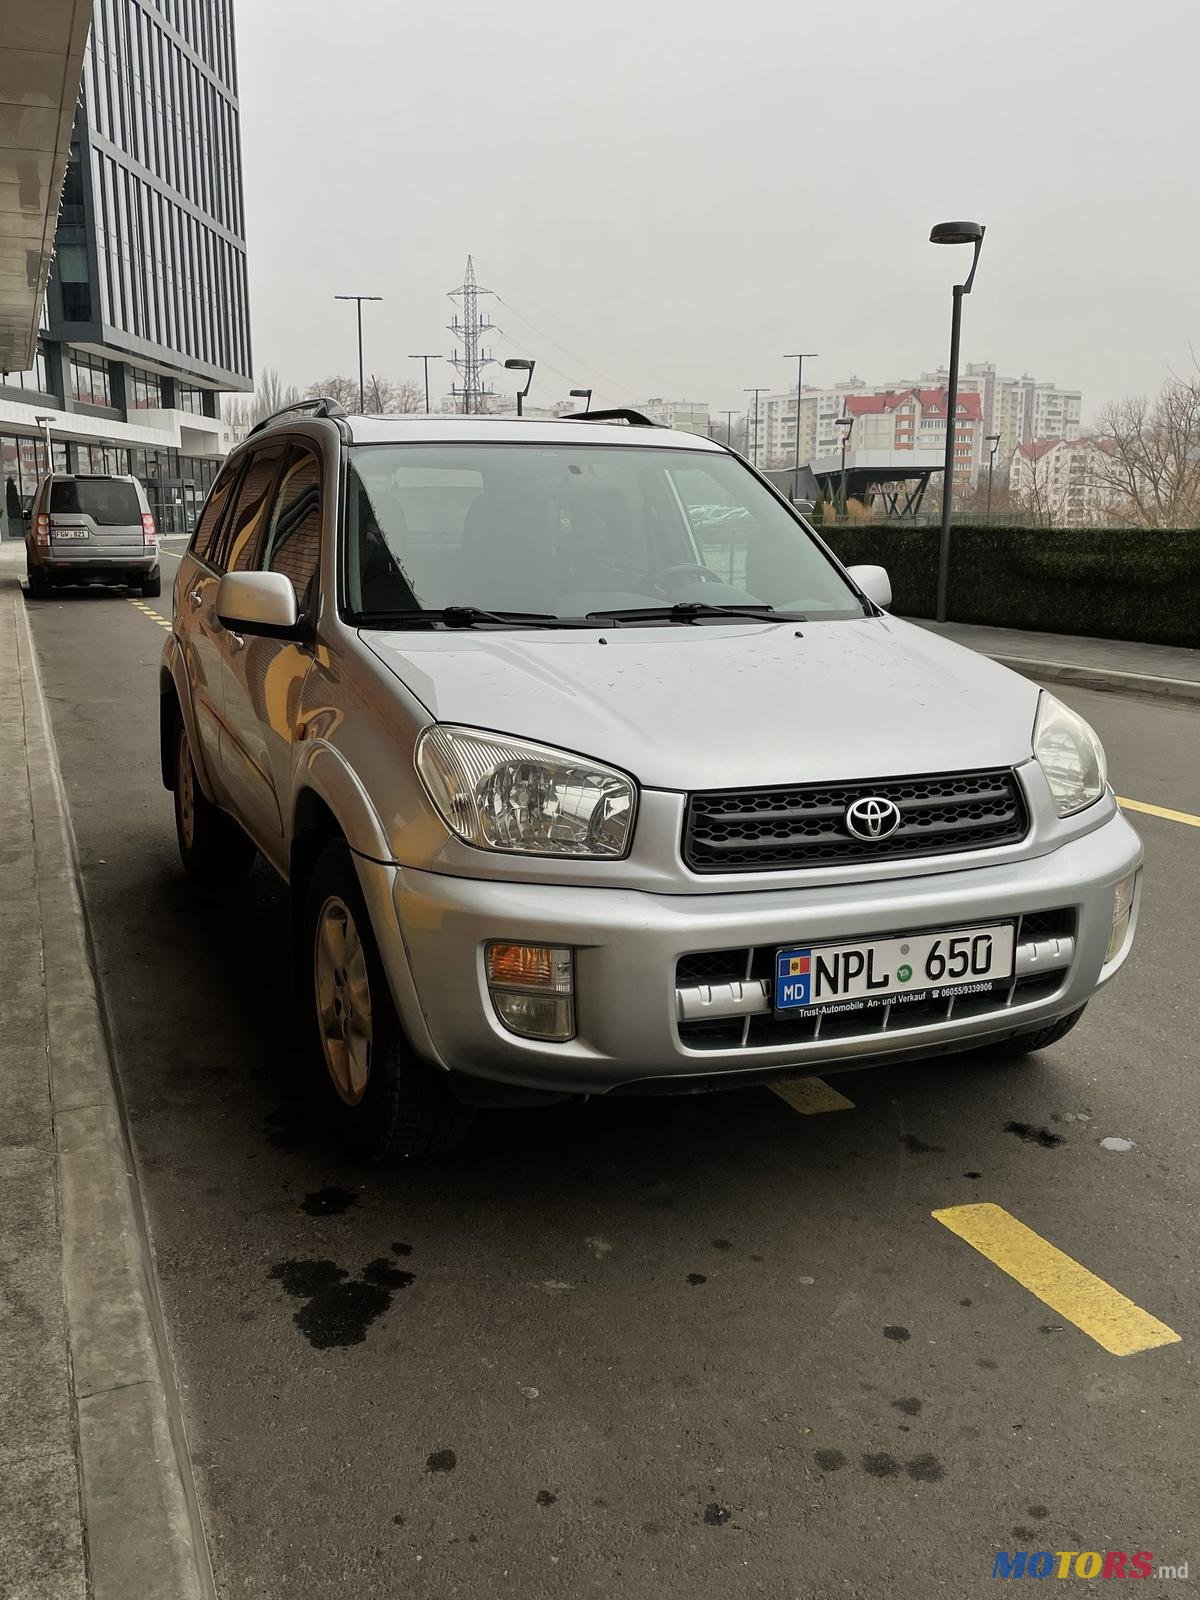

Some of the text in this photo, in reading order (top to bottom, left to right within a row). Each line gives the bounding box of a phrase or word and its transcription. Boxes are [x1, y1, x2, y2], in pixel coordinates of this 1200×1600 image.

[815, 934, 993, 997] NPL 650
[783, 984, 805, 1001] MD
[799, 983, 993, 1017] Trust-Automobile An- und Verkauf 06055/9339906
